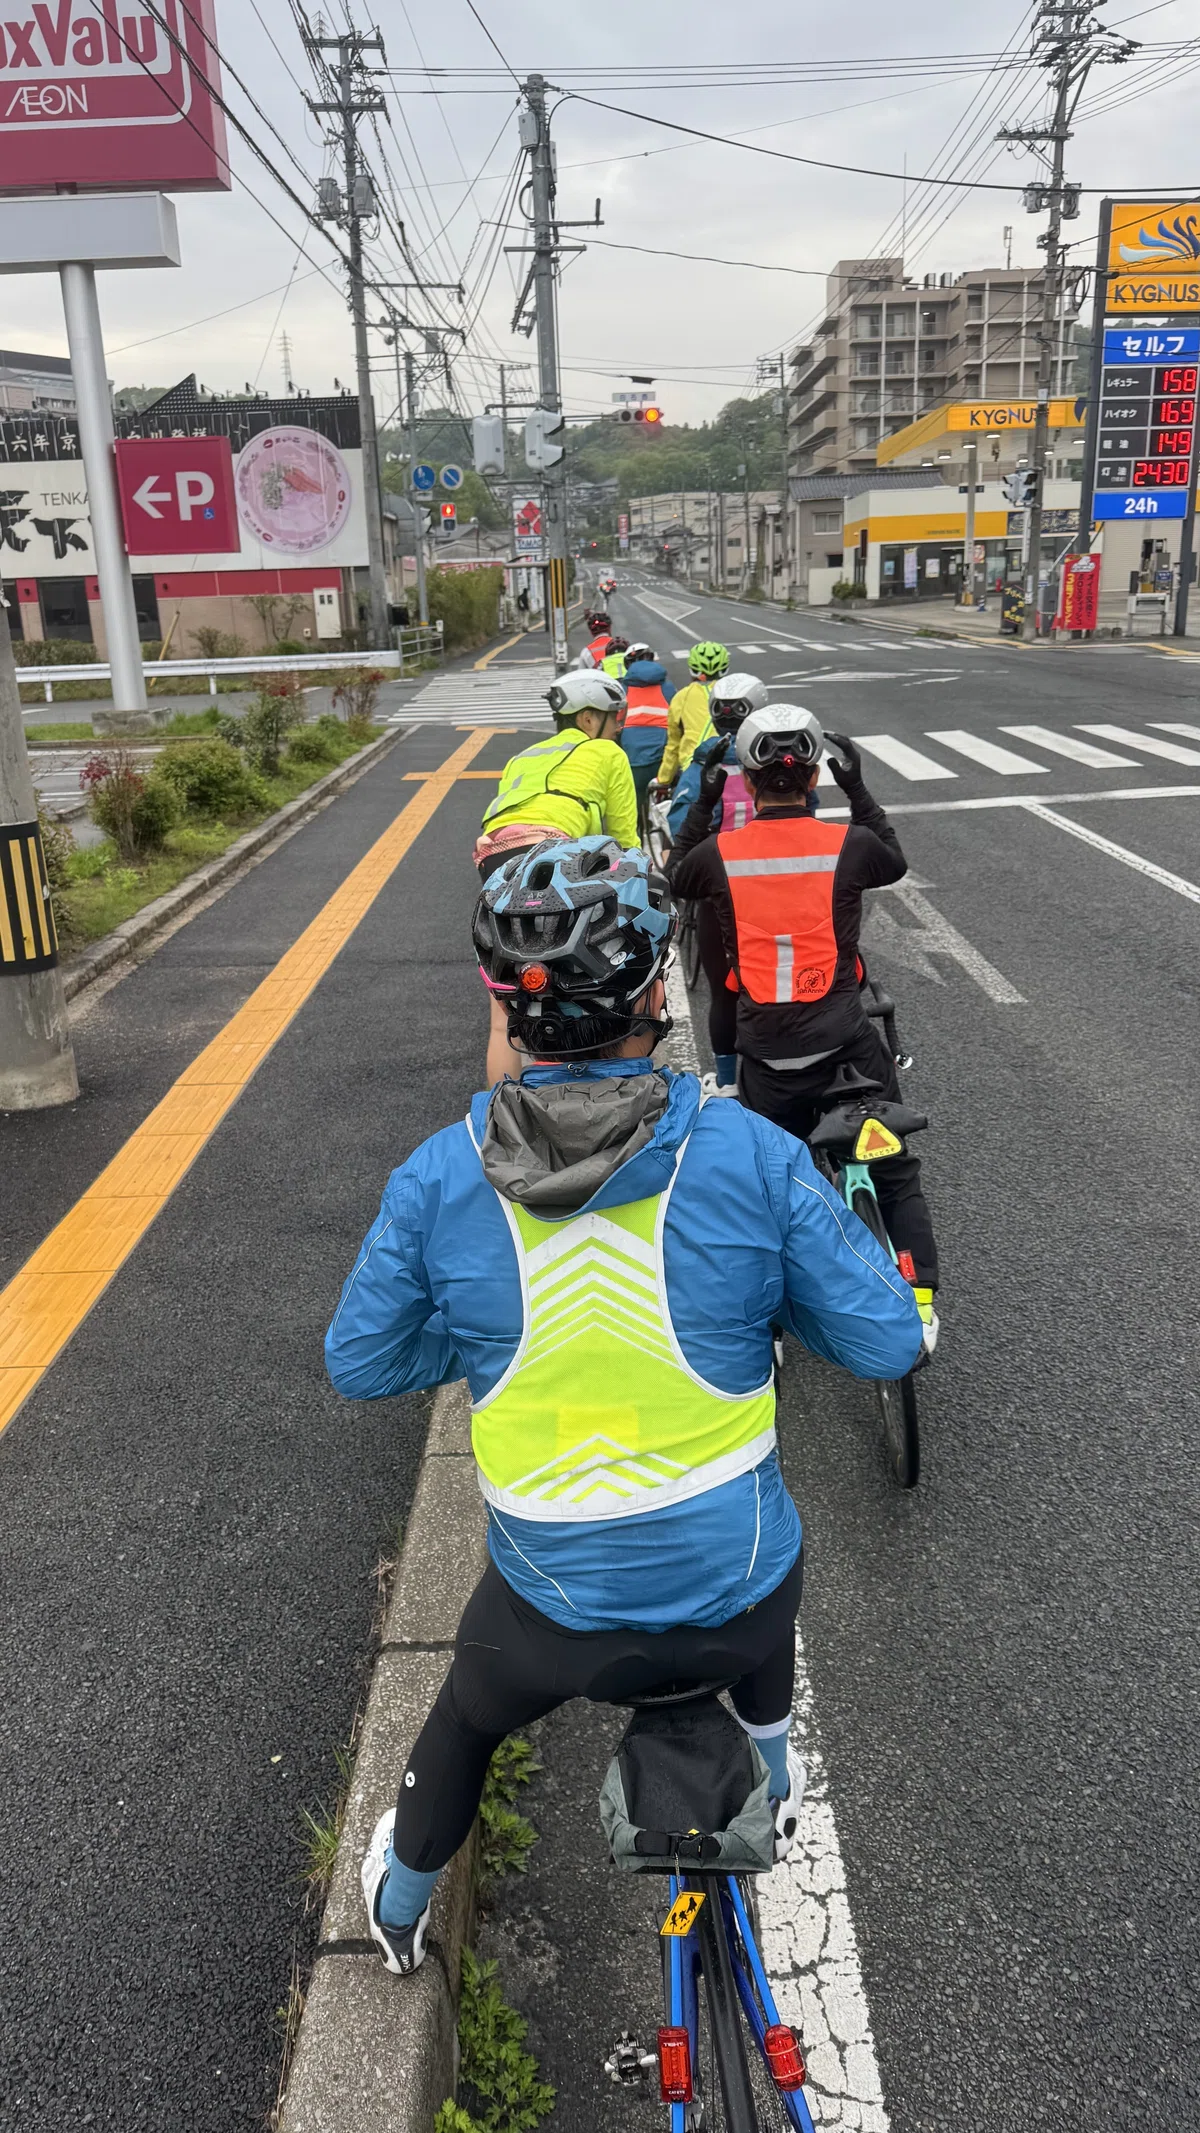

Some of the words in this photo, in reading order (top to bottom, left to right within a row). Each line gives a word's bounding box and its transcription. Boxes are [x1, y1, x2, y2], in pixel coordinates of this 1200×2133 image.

[0, 0, 158, 69] xValu
[1113, 283, 1200, 304] KYGNUS
[1122, 335, 1185, 357] セルフ
[1106, 377, 1140, 388] レギュラー
[1162, 369, 1197, 392] 158
[970, 408, 1037, 426] KYGNU
[1104, 409, 1138, 419] ハイオク
[1160, 400, 1194, 423] 169
[1157, 431, 1192, 454] 149
[1133, 461, 1189, 485] 2430
[175, 471, 215, 521] P
[1124, 497, 1158, 514] 24h
